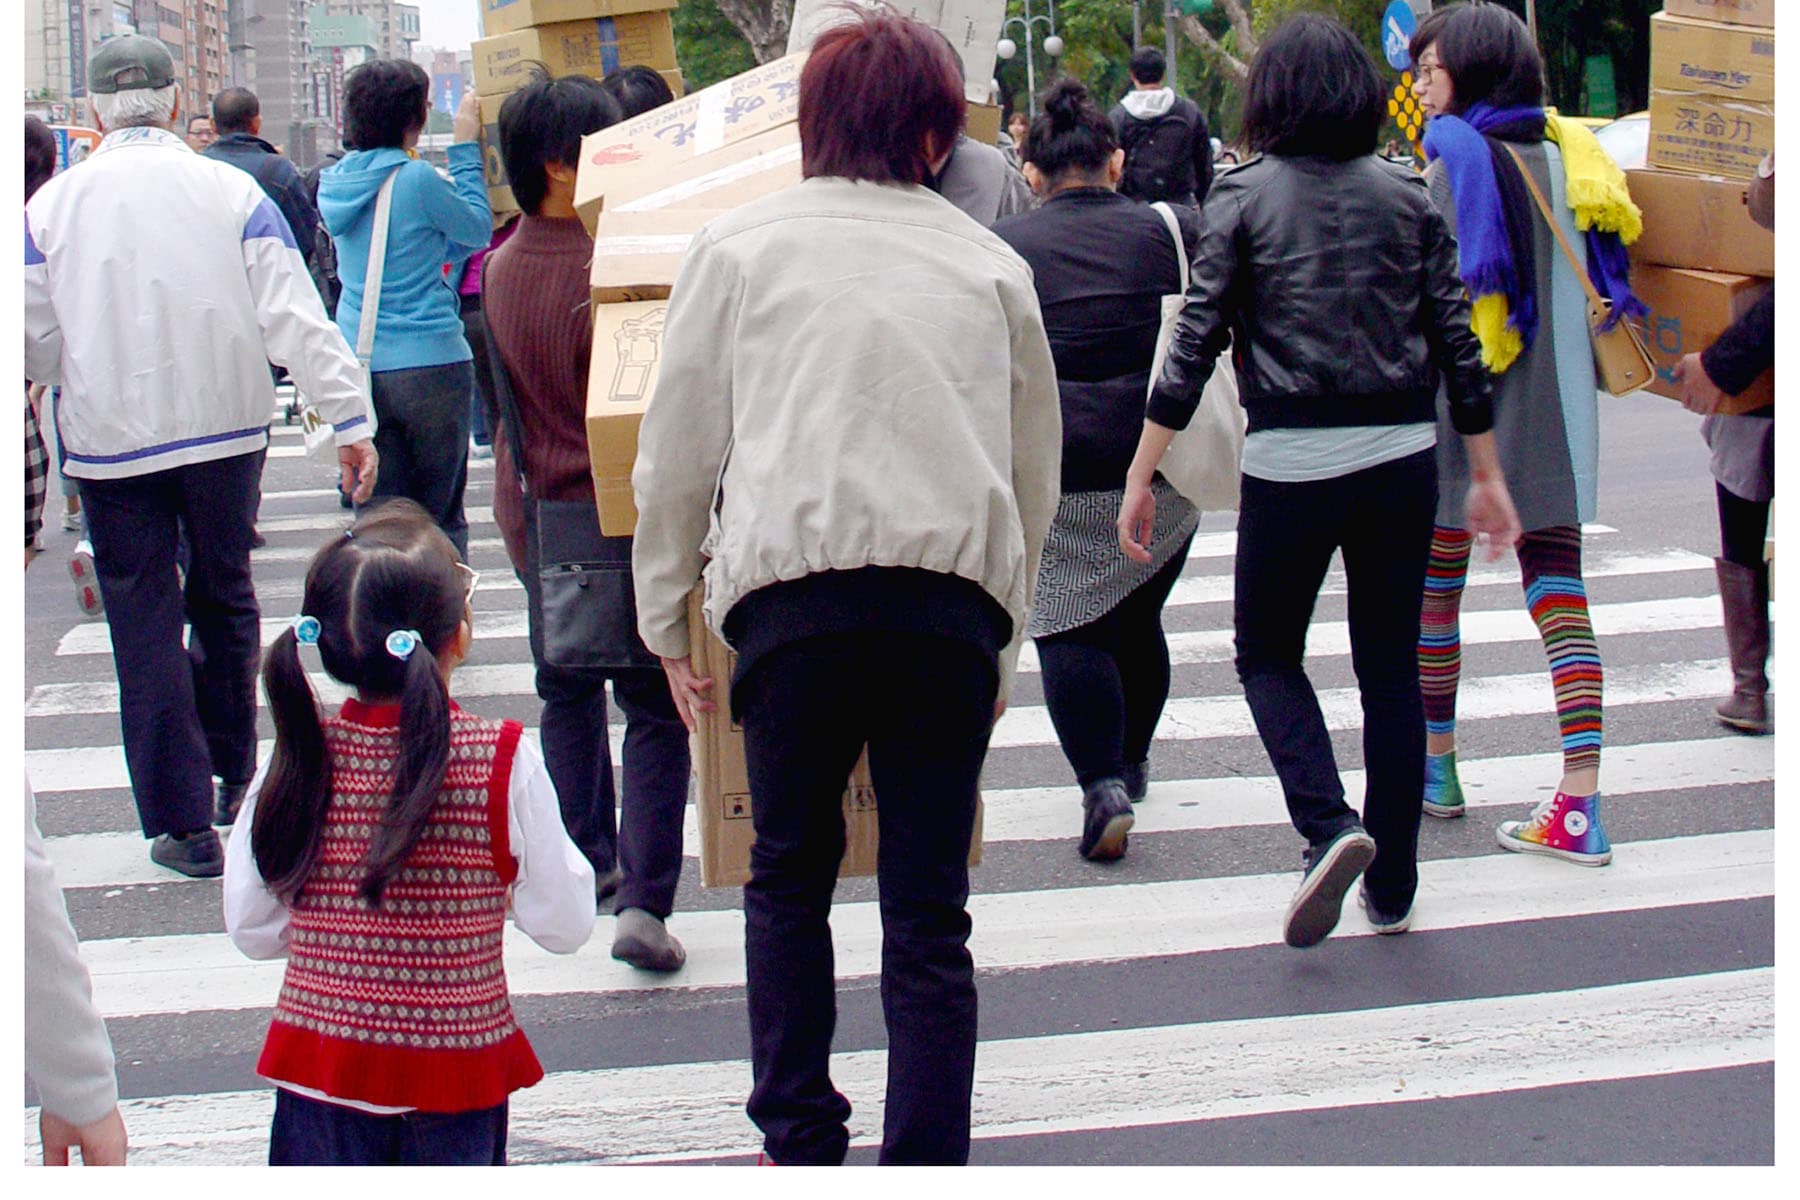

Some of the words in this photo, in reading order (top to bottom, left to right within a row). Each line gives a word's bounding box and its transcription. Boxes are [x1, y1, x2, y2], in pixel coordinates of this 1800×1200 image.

[1679, 63, 1728, 81] Taiwan
[1675, 106, 1753, 142] 深命力
